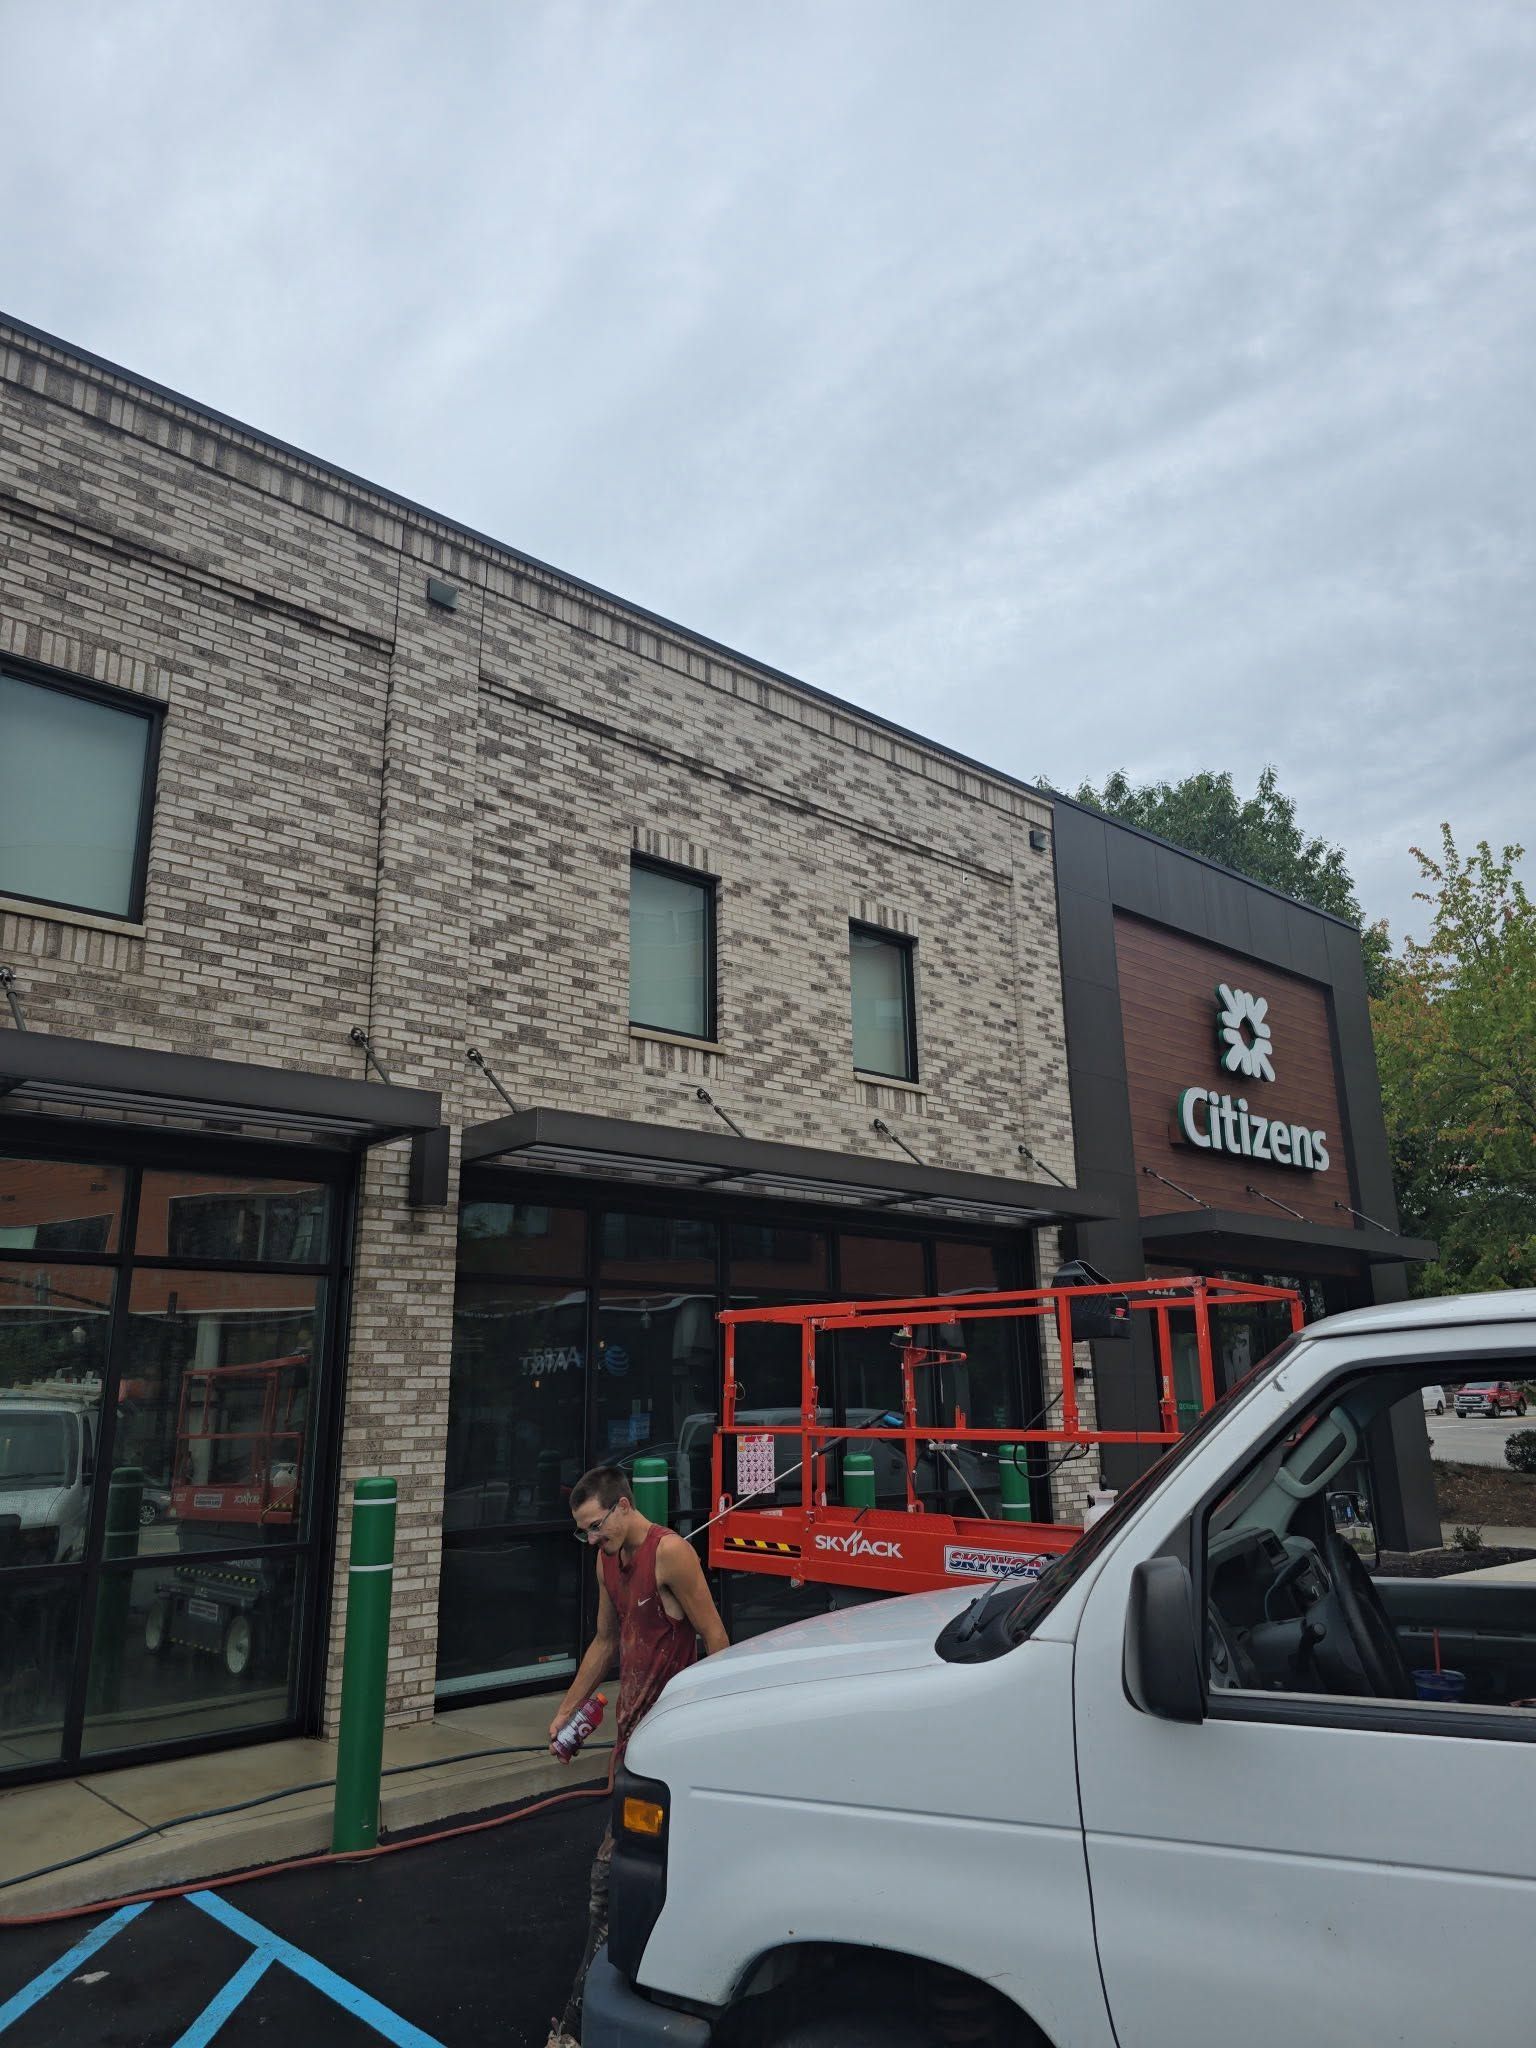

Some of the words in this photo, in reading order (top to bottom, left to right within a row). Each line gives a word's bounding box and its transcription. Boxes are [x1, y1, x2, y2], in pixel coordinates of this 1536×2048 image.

[1180, 1087, 1330, 1171] Citizens
[815, 1530, 903, 1559] SKYJACK
[949, 1551, 1045, 1578] SKYWOR
